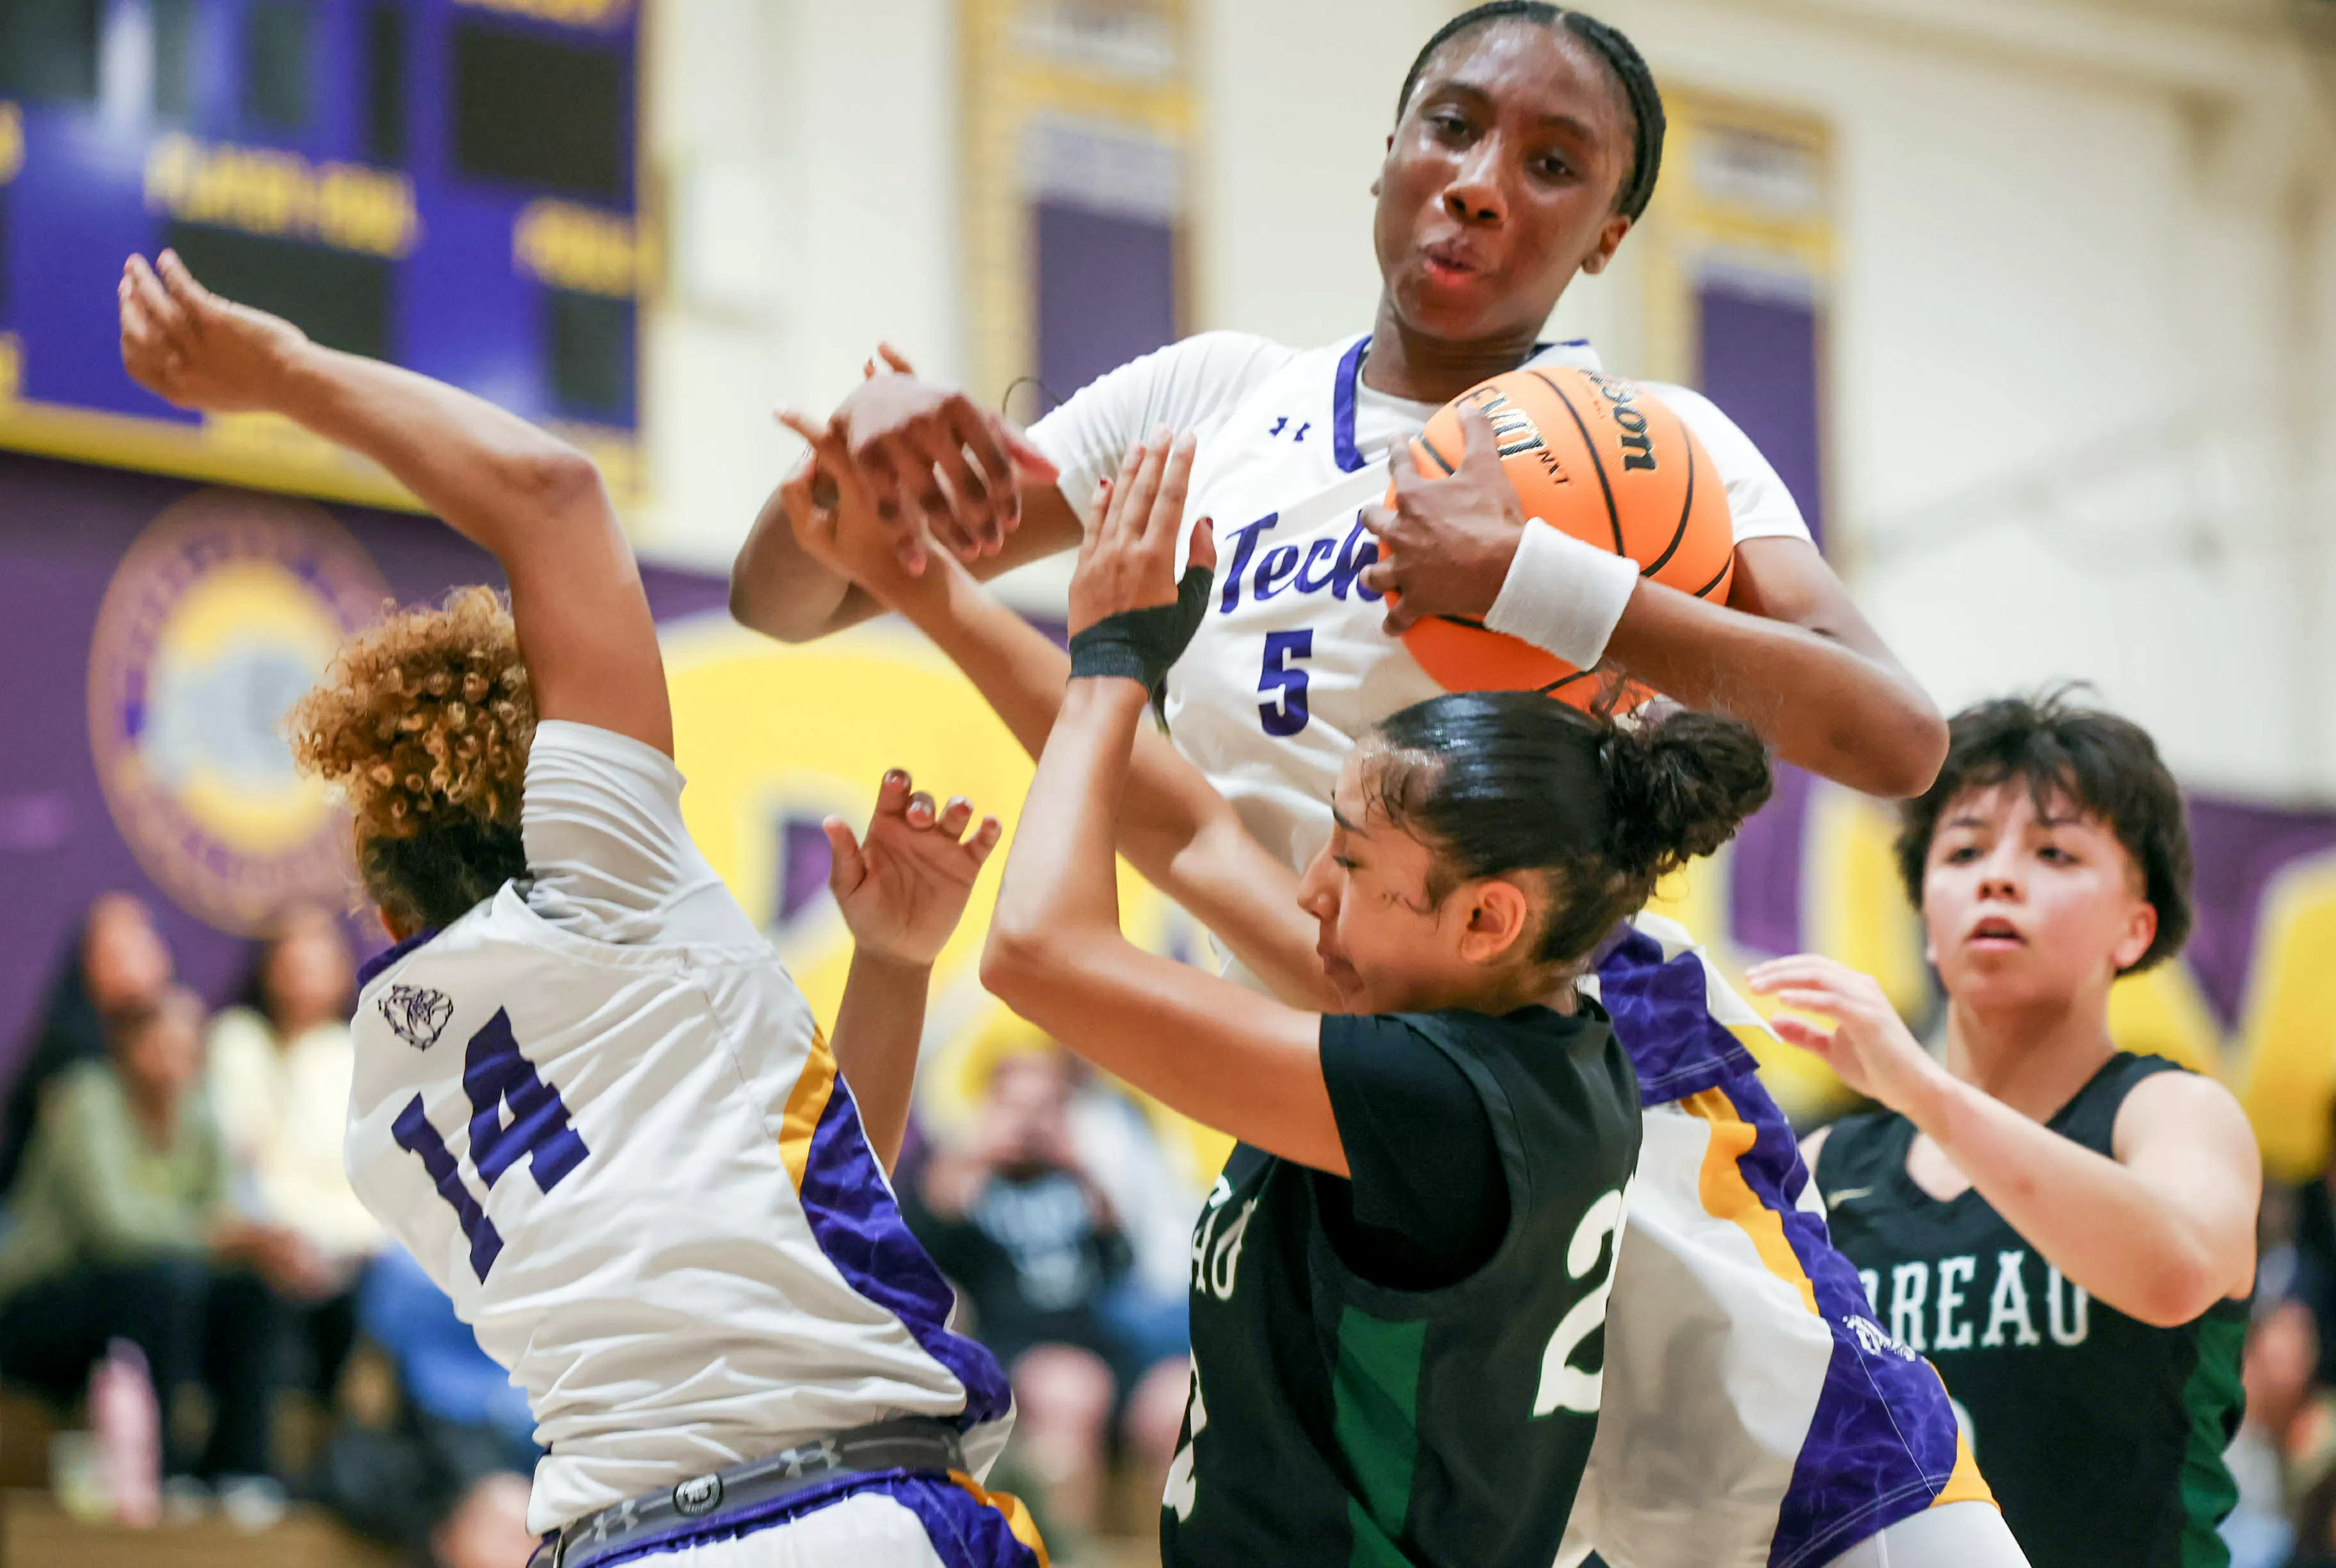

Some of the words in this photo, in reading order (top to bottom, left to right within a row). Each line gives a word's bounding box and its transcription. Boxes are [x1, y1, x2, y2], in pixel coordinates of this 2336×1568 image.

[1219, 508, 1384, 614] Tech
[1257, 628, 1314, 737] 5
[391, 1004, 591, 1286] 14
